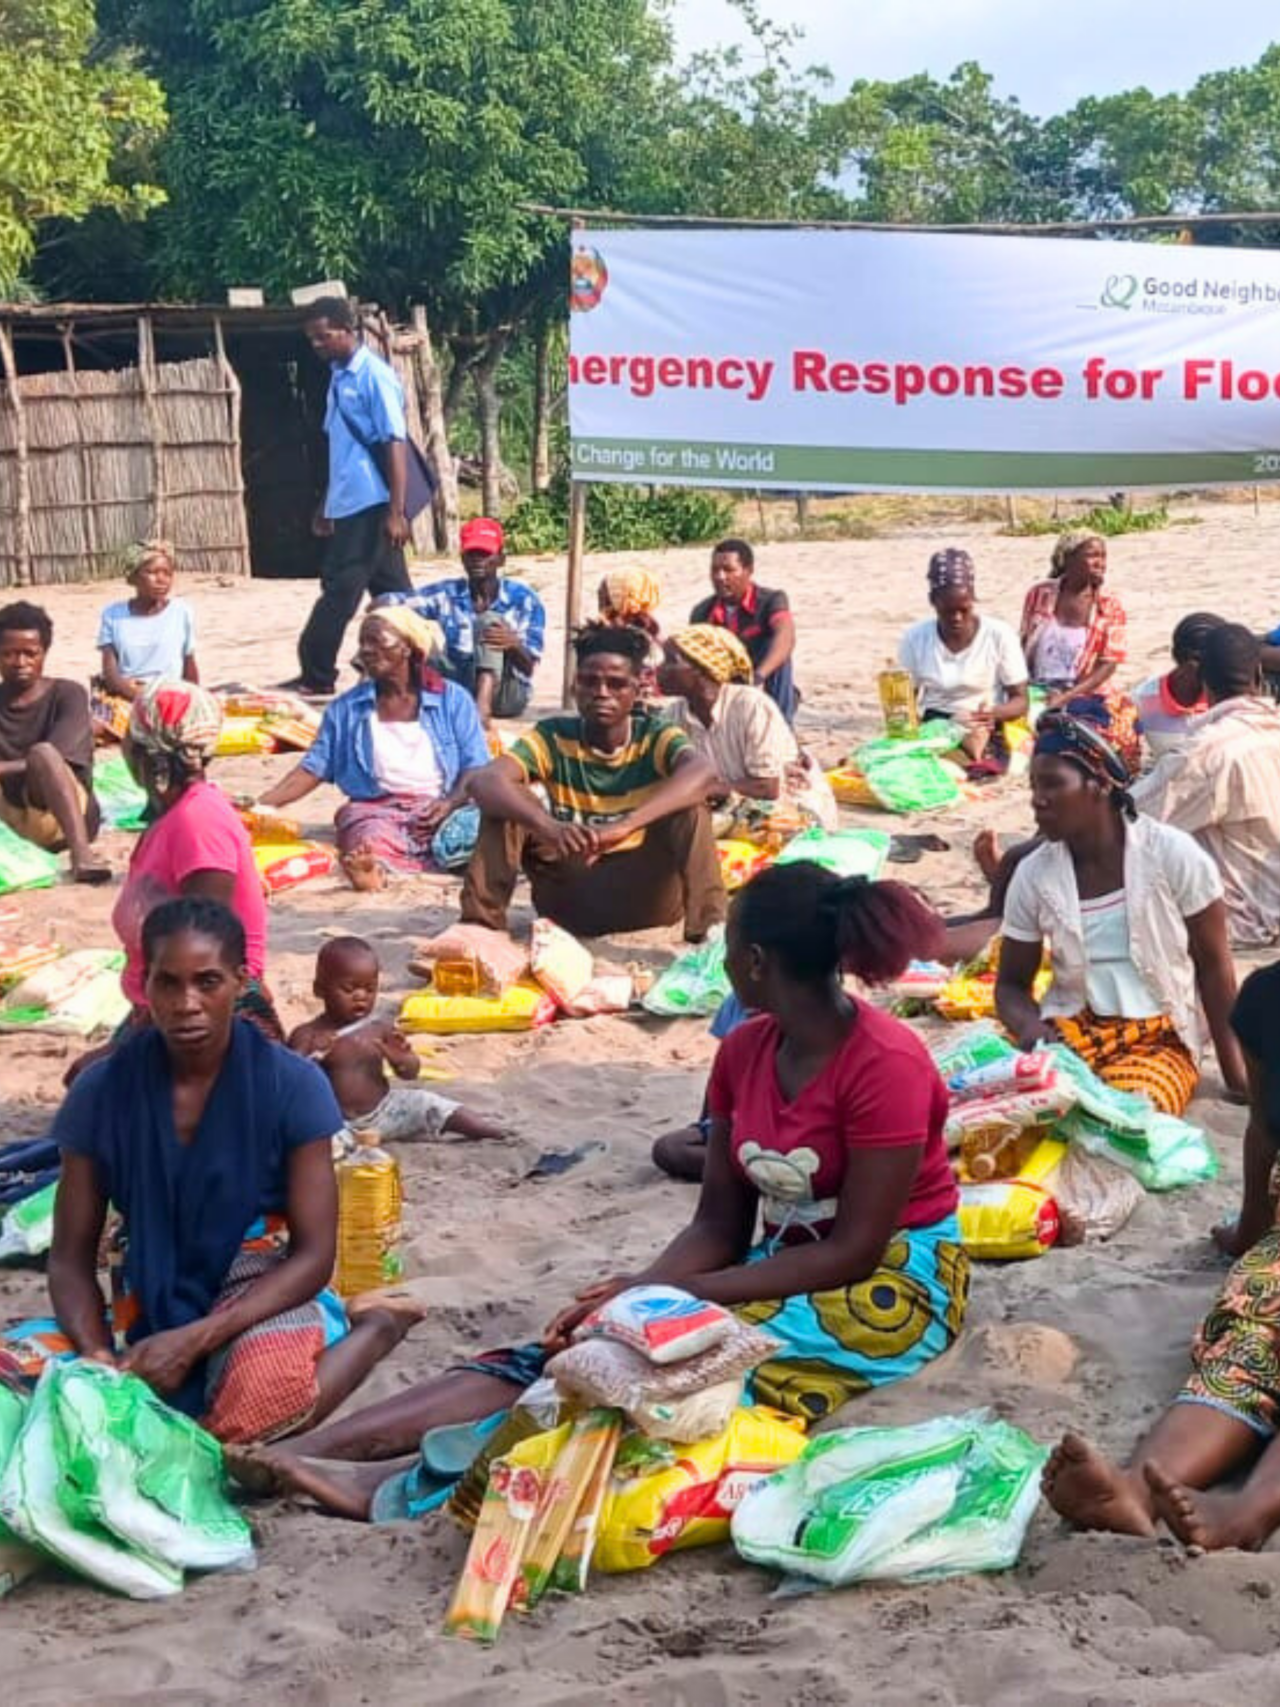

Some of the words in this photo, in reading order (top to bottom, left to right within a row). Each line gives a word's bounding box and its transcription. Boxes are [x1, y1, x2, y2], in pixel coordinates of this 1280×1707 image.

[1143, 277, 1198, 298] Good
[568, 354, 773, 401] ergency
[793, 351, 1063, 406] Response
[1083, 358, 1162, 400] for
[577, 443, 645, 470] Change
[650, 446, 677, 467] for
[681, 448, 711, 469] the
[716, 449, 774, 472] World
